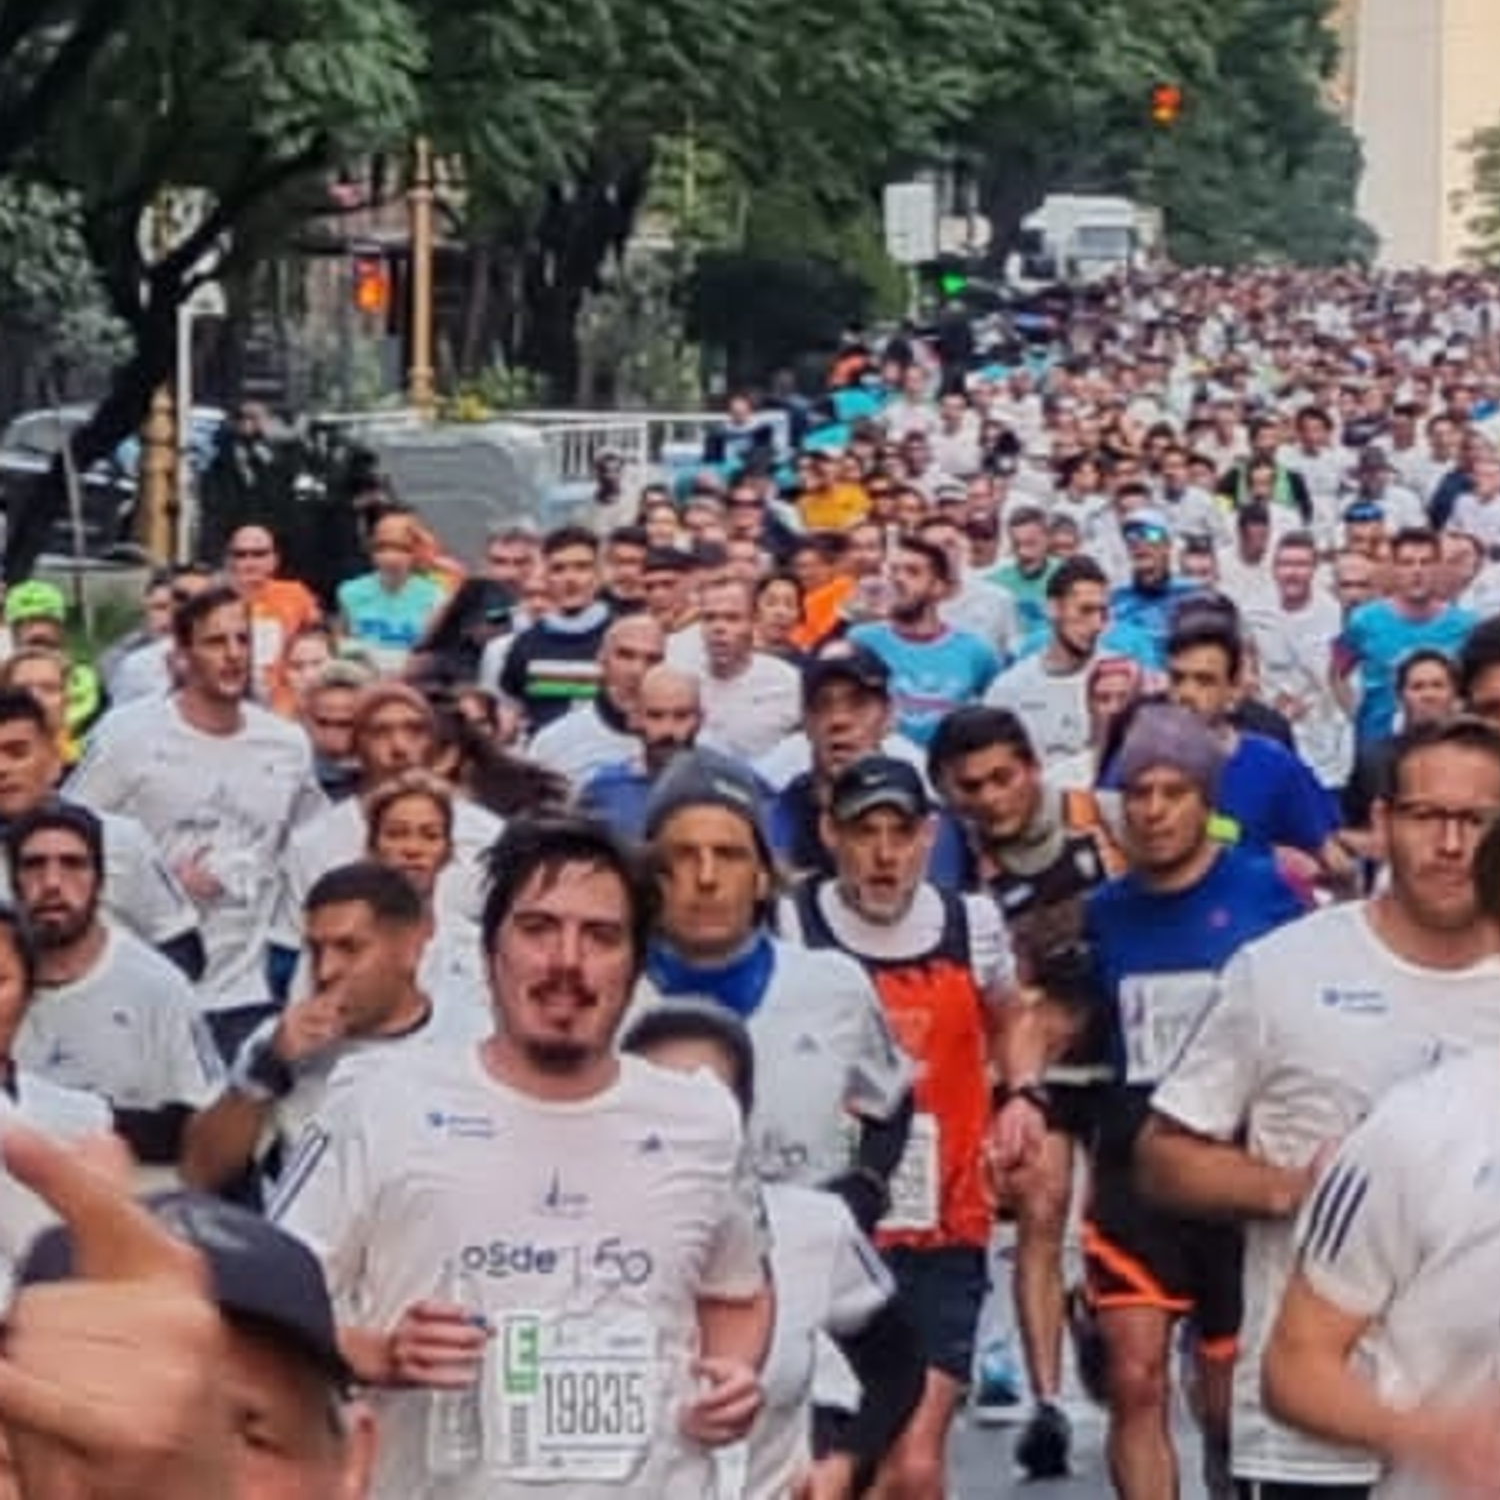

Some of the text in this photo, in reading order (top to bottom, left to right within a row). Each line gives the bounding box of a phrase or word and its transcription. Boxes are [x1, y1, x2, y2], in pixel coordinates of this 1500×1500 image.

[461, 1237, 654, 1289] osde 50
[543, 1371, 646, 1436] 19835
